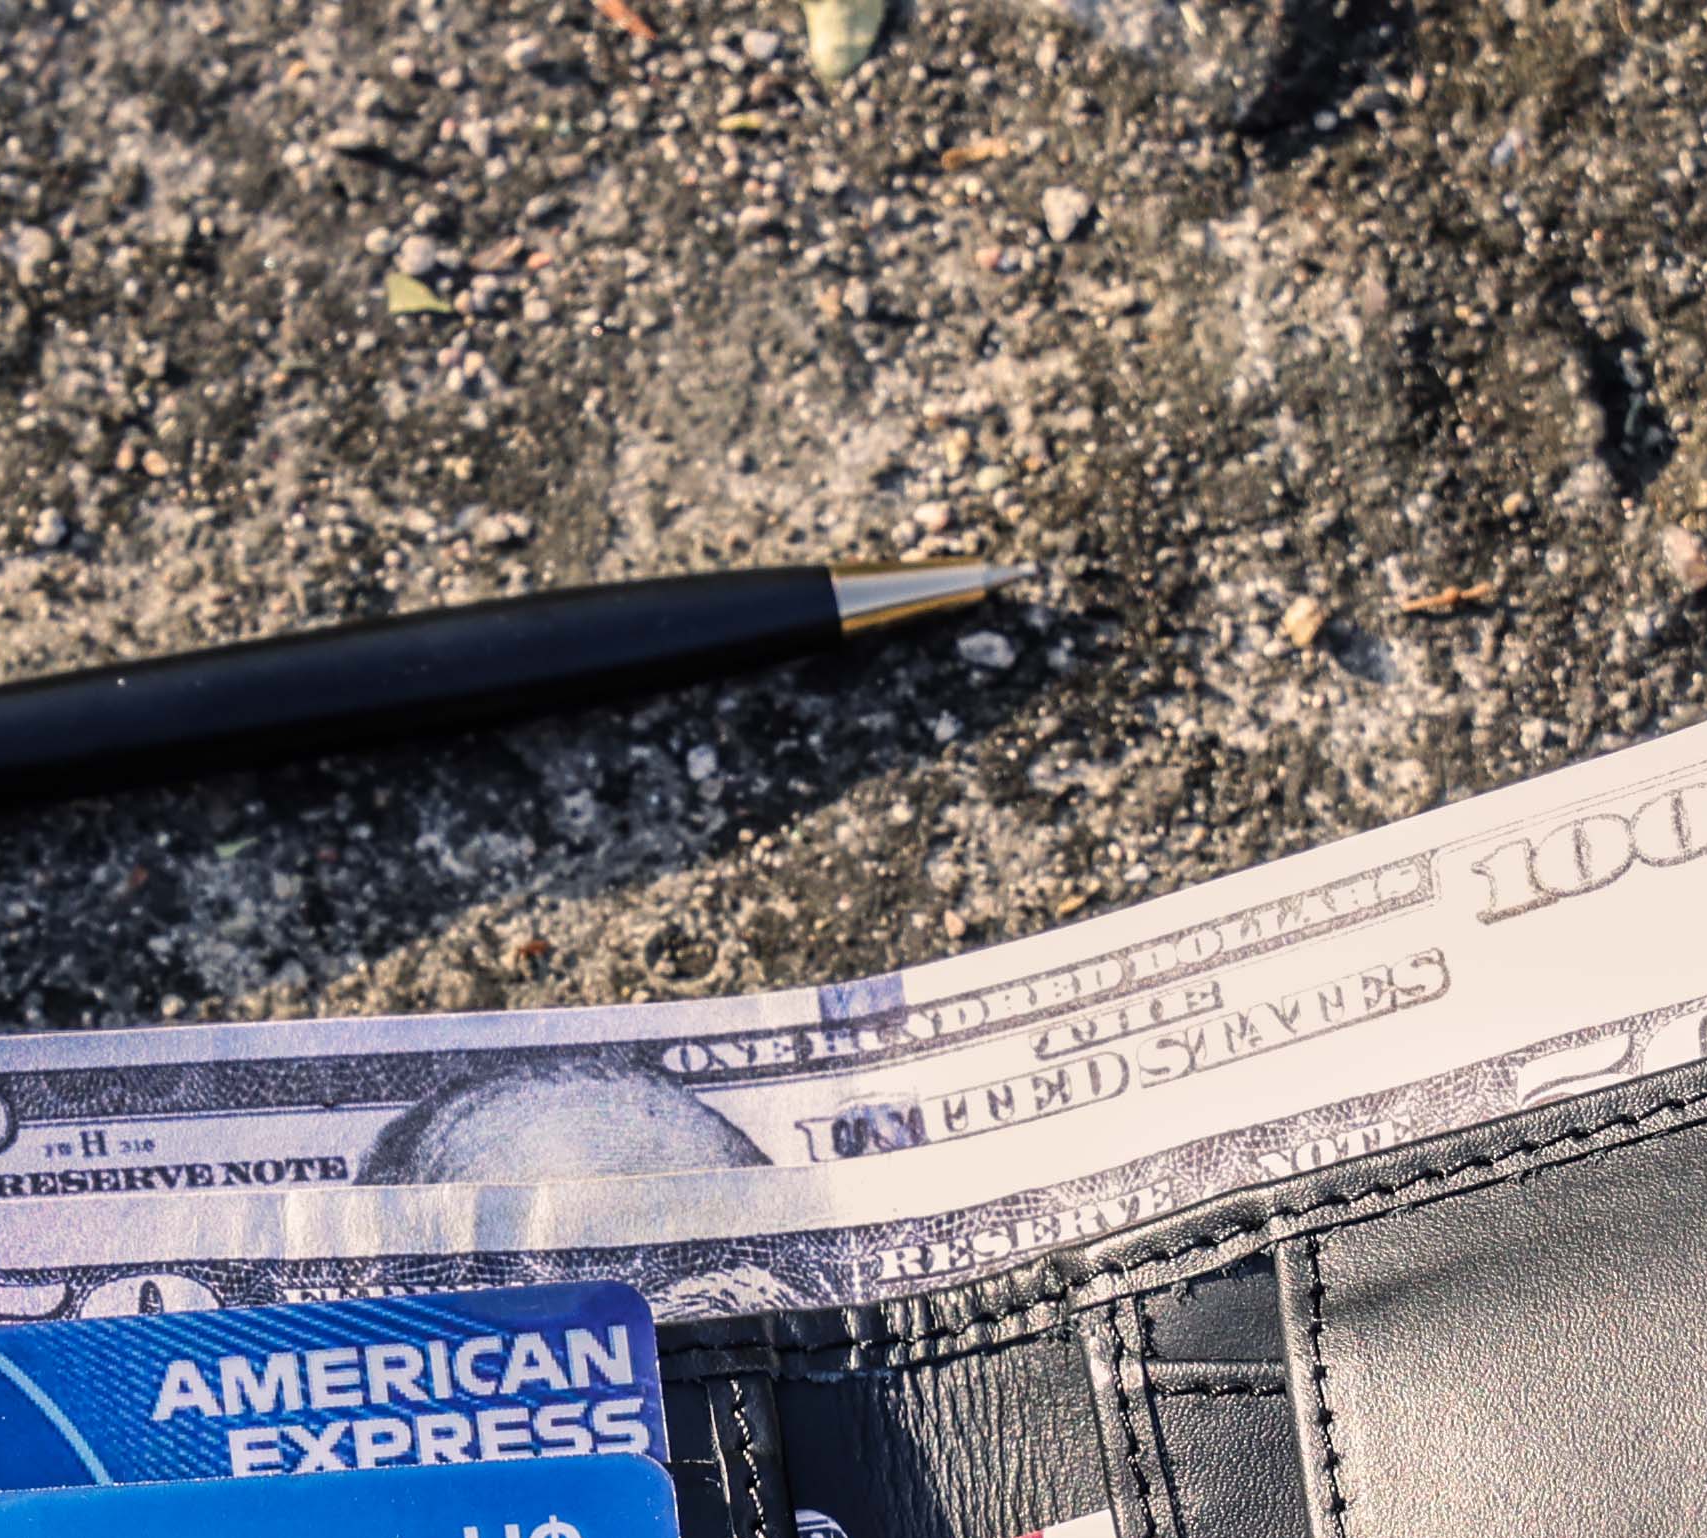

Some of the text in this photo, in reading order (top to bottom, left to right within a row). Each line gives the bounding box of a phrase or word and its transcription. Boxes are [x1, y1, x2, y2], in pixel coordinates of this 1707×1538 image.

[661, 1030, 795, 1075] ONE
[218, 1155, 348, 1187] NOTE
[876, 1182, 1175, 1282] RESERVE
[152, 1324, 633, 1421] AMERICAN
[227, 1398, 650, 1478] EXPRESS
